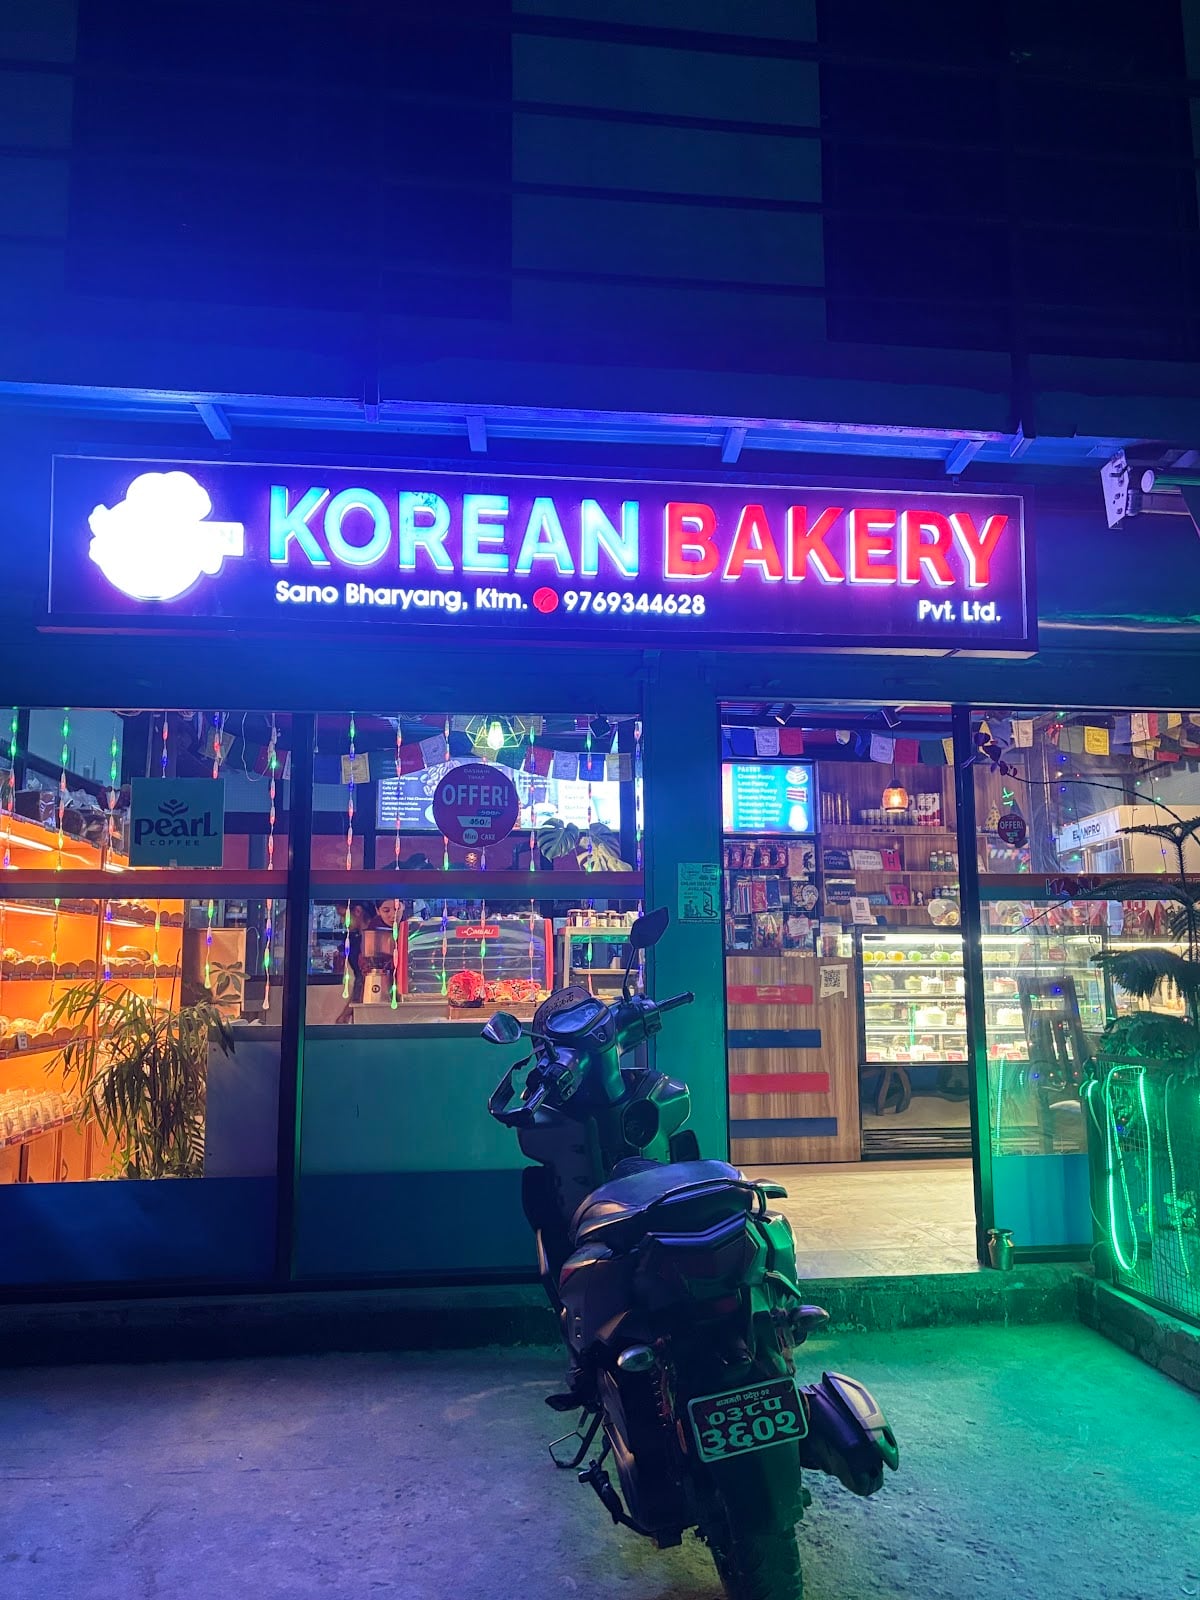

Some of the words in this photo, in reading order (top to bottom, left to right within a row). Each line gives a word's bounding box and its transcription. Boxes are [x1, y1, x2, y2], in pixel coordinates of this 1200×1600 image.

[269, 485, 641, 578] KOREAN
[663, 501, 1009, 589] BAKERY
[275, 580, 339, 604] Sano
[345, 583, 469, 612] Bharyang,
[476, 588, 529, 611] Ktm.
[563, 590, 706, 616] 9769344628
[918, 599, 956, 621] Pvt.
[962, 600, 1002, 622] Ltd.
[442, 784, 509, 807] OFFER!
[1000, 820, 1024, 830] OFFER!
[150, 839, 200, 847] COFFEE
[701, 1410, 800, 1456] ३६०२
